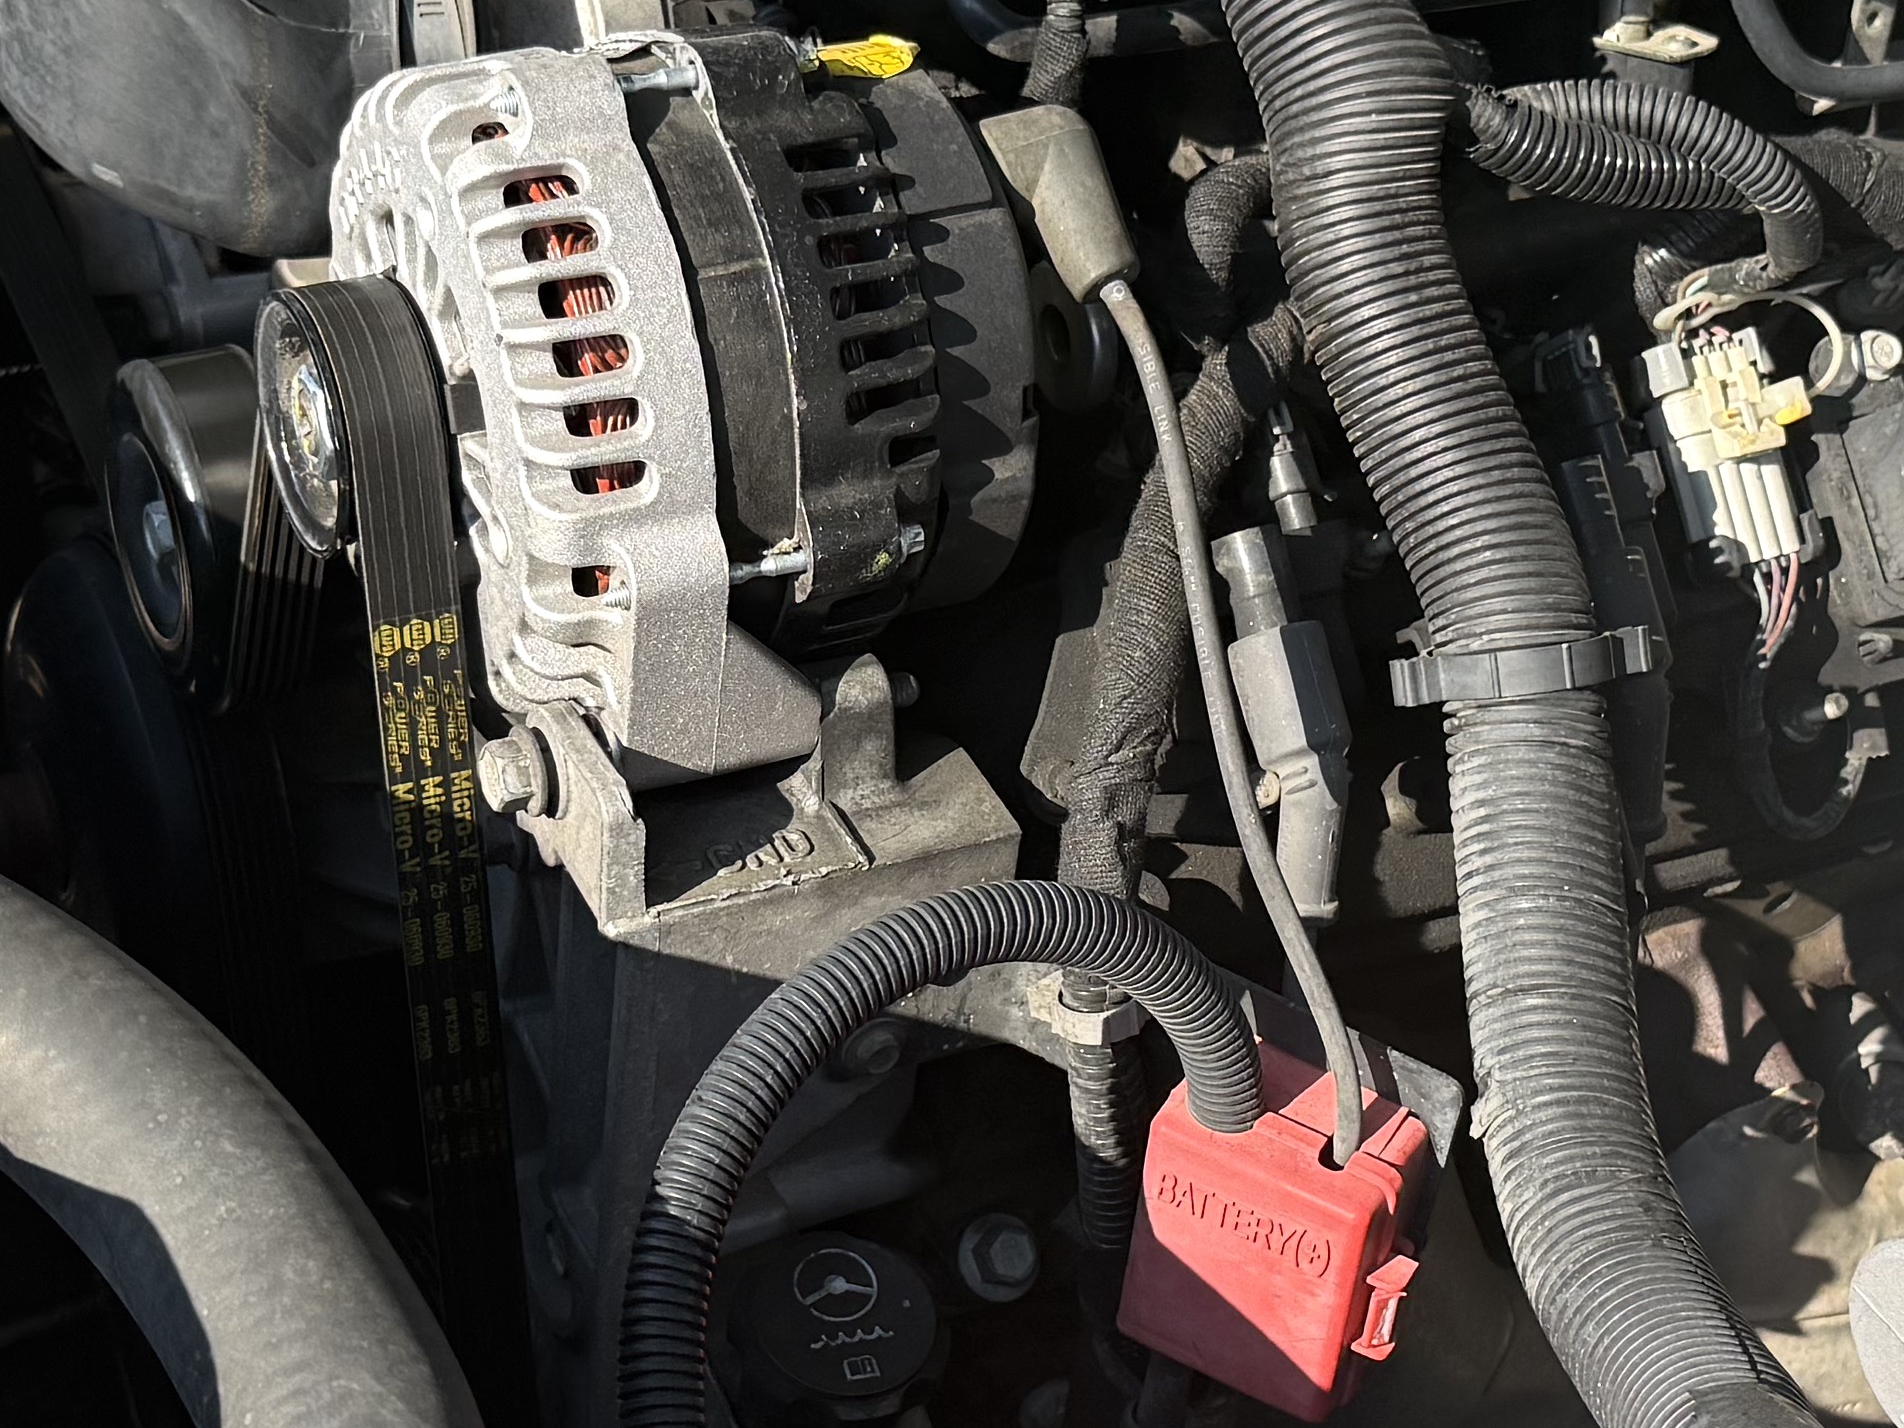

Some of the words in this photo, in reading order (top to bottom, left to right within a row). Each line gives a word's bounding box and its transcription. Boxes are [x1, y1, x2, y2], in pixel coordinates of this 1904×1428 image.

[1153, 404, 1173, 443] LINK
[391, 782, 422, 872] Micro-V
[421, 776, 451, 866] Micro-V
[451, 769, 480, 859] Micro-V
